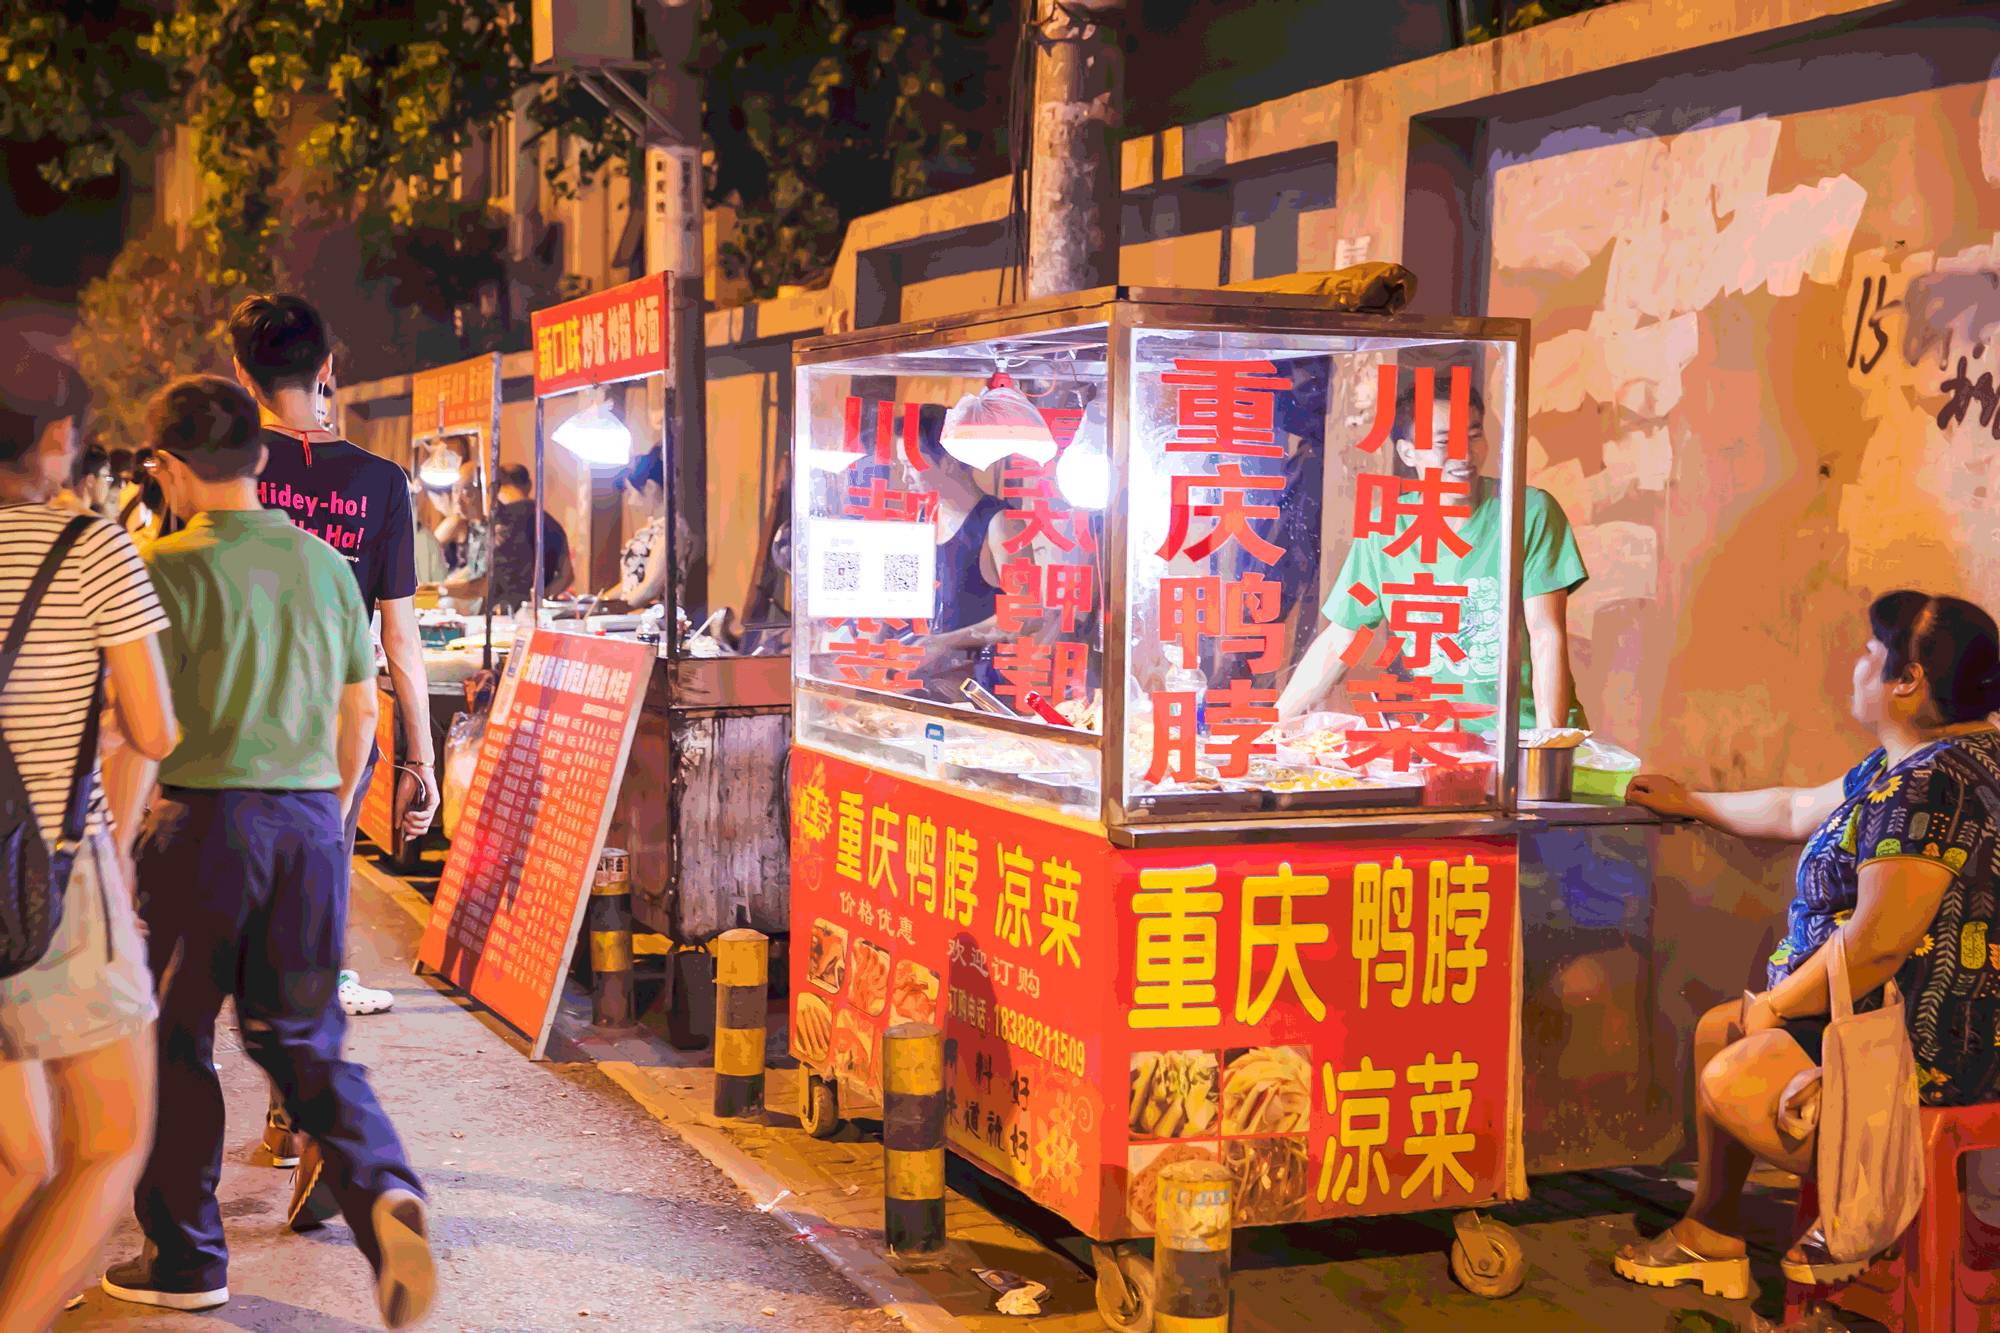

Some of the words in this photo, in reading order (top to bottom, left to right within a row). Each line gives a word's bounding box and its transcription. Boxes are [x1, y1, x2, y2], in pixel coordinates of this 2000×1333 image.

[1143, 357, 1293, 786] 重庆鸭脖
[1338, 363, 1474, 773] 川味凉菜
[836, 790, 979, 927] 重庆鸭脖
[994, 841, 1082, 969] 凉菜
[839, 890, 916, 946] 价格优惠
[1127, 854, 1491, 1029] 重庆鸭脖
[947, 938, 1041, 1000] 欢迎订购
[1317, 1050, 1479, 1206] 凉菜
